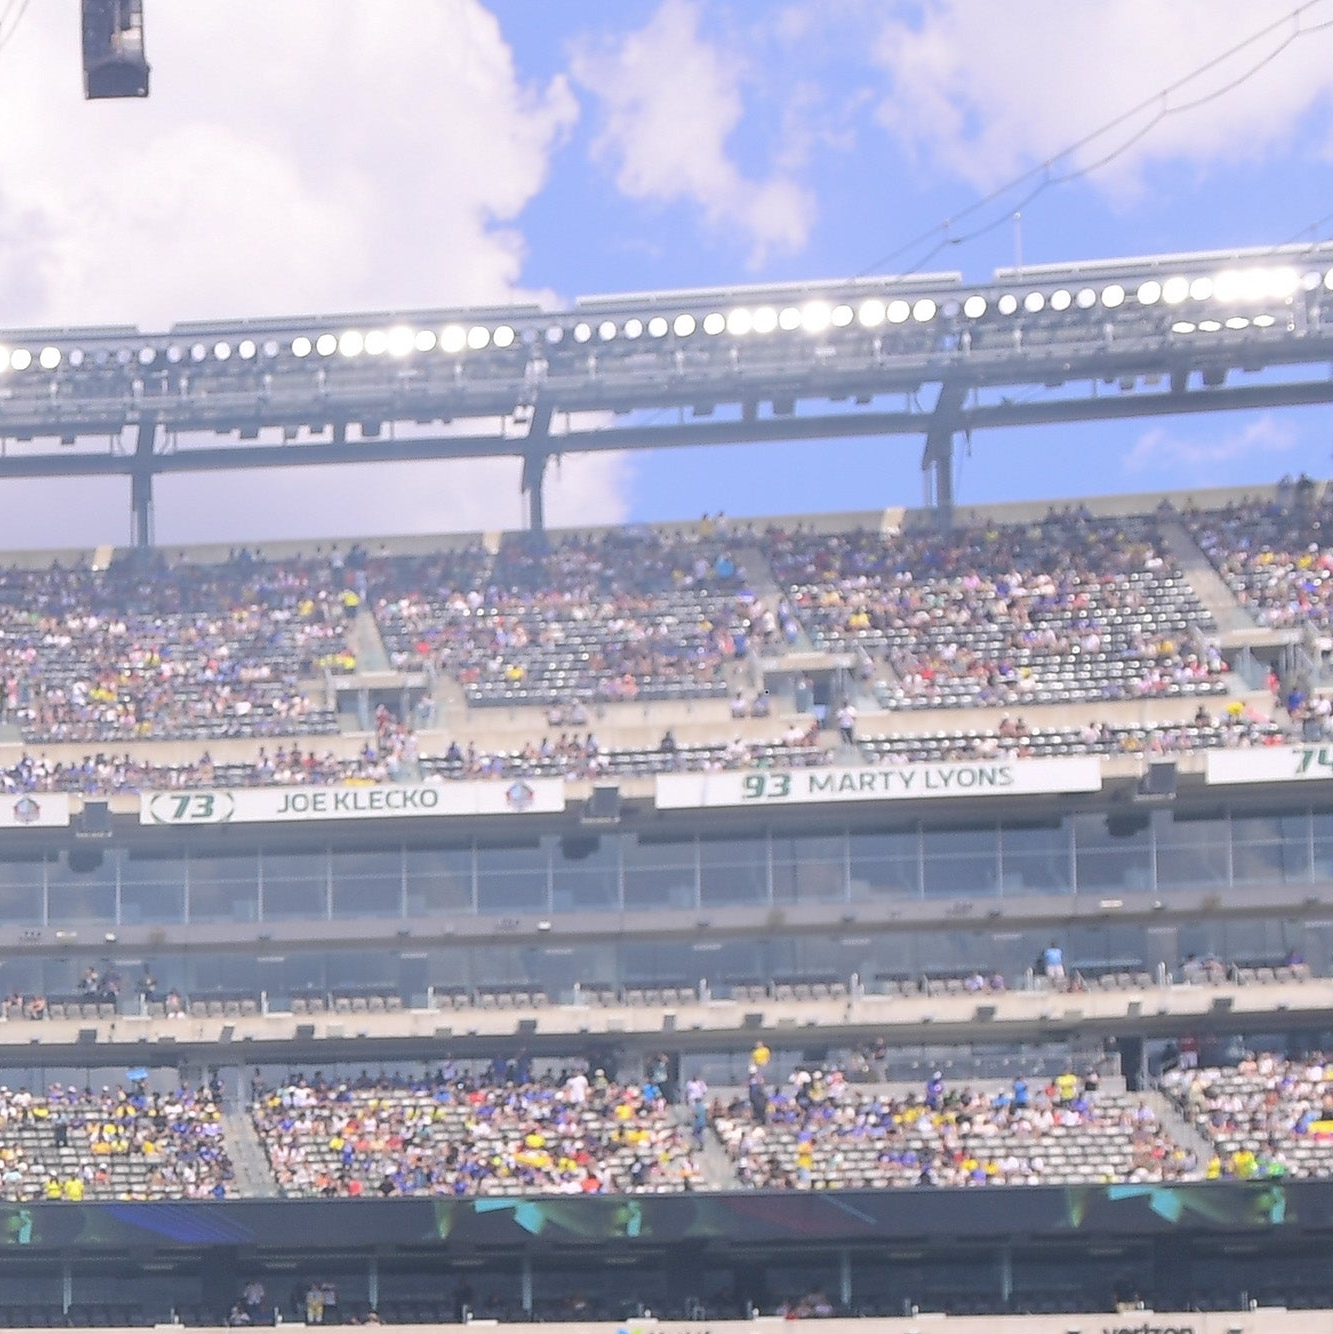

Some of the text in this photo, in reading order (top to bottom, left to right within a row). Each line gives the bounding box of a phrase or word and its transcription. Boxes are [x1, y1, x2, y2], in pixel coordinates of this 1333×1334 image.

[742, 764, 1014, 799] 93 MARTY LYONS
[170, 788, 438, 819] 73 JOE KLECKO
